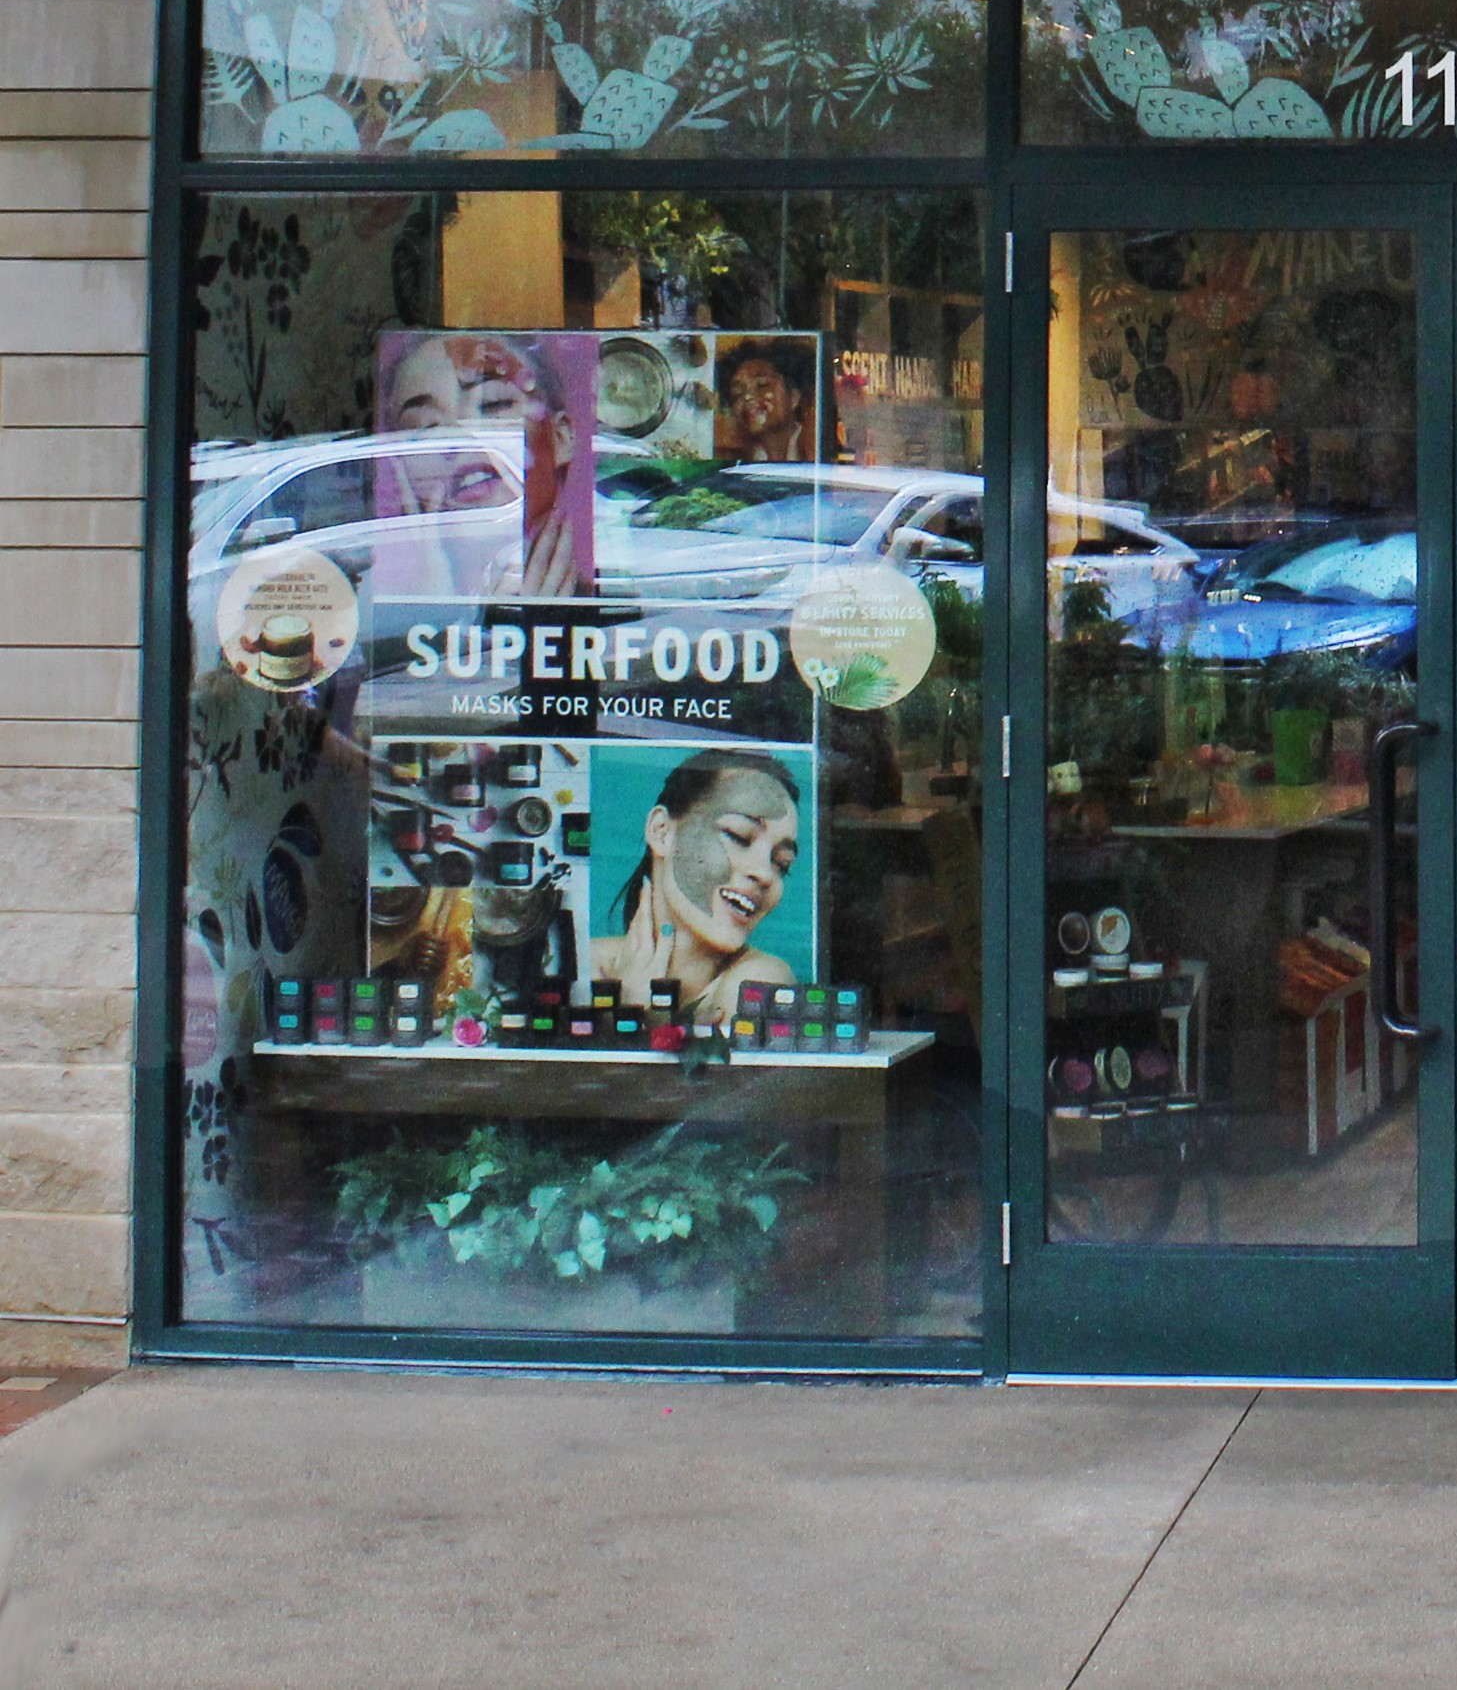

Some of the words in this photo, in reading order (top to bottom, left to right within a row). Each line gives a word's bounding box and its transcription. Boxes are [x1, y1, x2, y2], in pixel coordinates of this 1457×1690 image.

[861, 605, 926, 620] SERVICES
[874, 626, 908, 638] TODAY
[405, 623, 781, 684] SUPERFOOD
[451, 695, 534, 716] MASKS
[541, 696, 589, 716] FOR
[598, 696, 665, 718] YOUR
[672, 698, 733, 720] FACE
